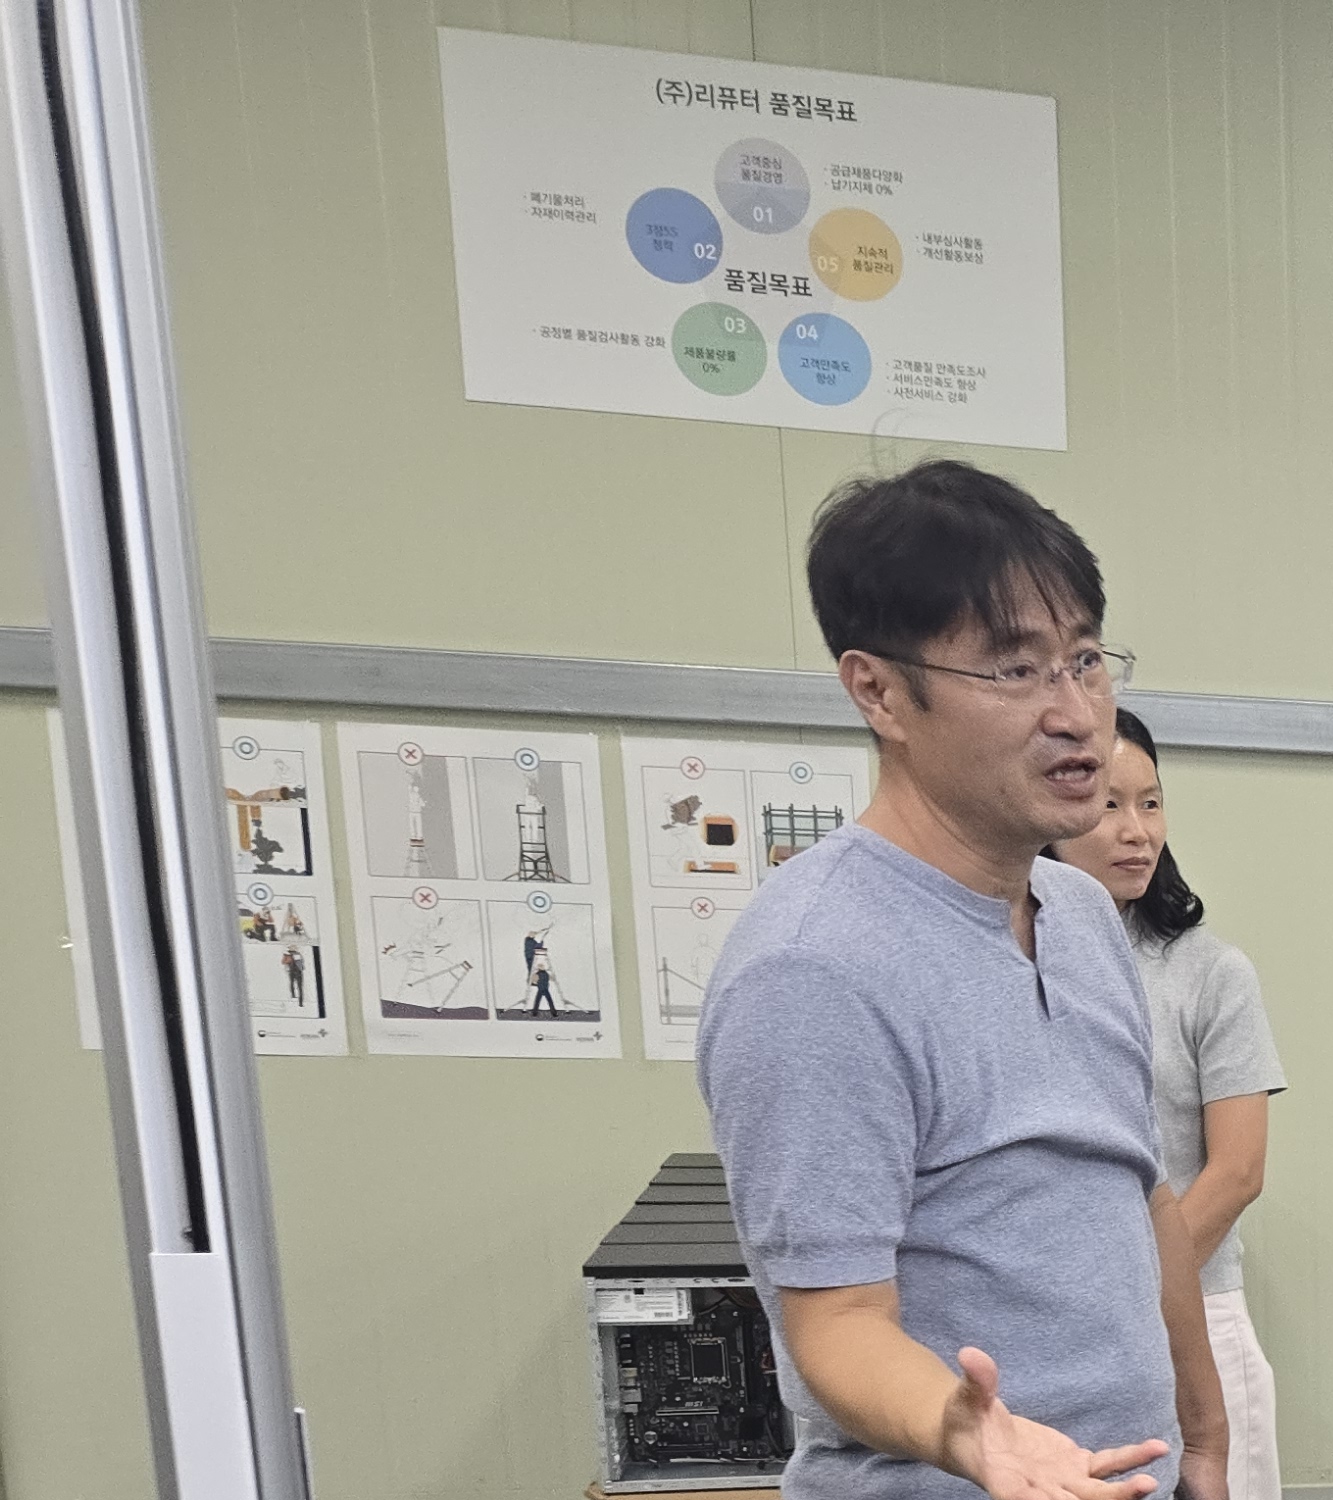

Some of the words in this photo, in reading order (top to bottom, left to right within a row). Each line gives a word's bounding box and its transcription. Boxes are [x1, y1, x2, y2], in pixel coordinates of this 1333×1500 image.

[656, 77, 760, 114] (주)리퓨터
[768, 91, 858, 123] 품질목표
[875, 183, 894, 196] 0%
[531, 206, 597, 224] 자재이력관리
[753, 206, 774, 223] 01
[922, 231, 983, 251] 내부심사활동
[694, 242, 717, 261] 02
[857, 245, 888, 260] 지속적
[817, 255, 839, 273] 05
[852, 259, 894, 275] 품질관리
[724, 267, 813, 298] 품질목표
[540, 325, 574, 340] 공정별
[724, 316, 747, 334] 03
[795, 323, 818, 340] 04
[702, 361, 721, 374] 0%
[799, 357, 852, 373] 고객만족도
[893, 359, 933, 374] 고객품질
[936, 362, 986, 379] 만족도조사
[816, 372, 837, 386] 향상
[893, 373, 953, 389] 서비스만족도
